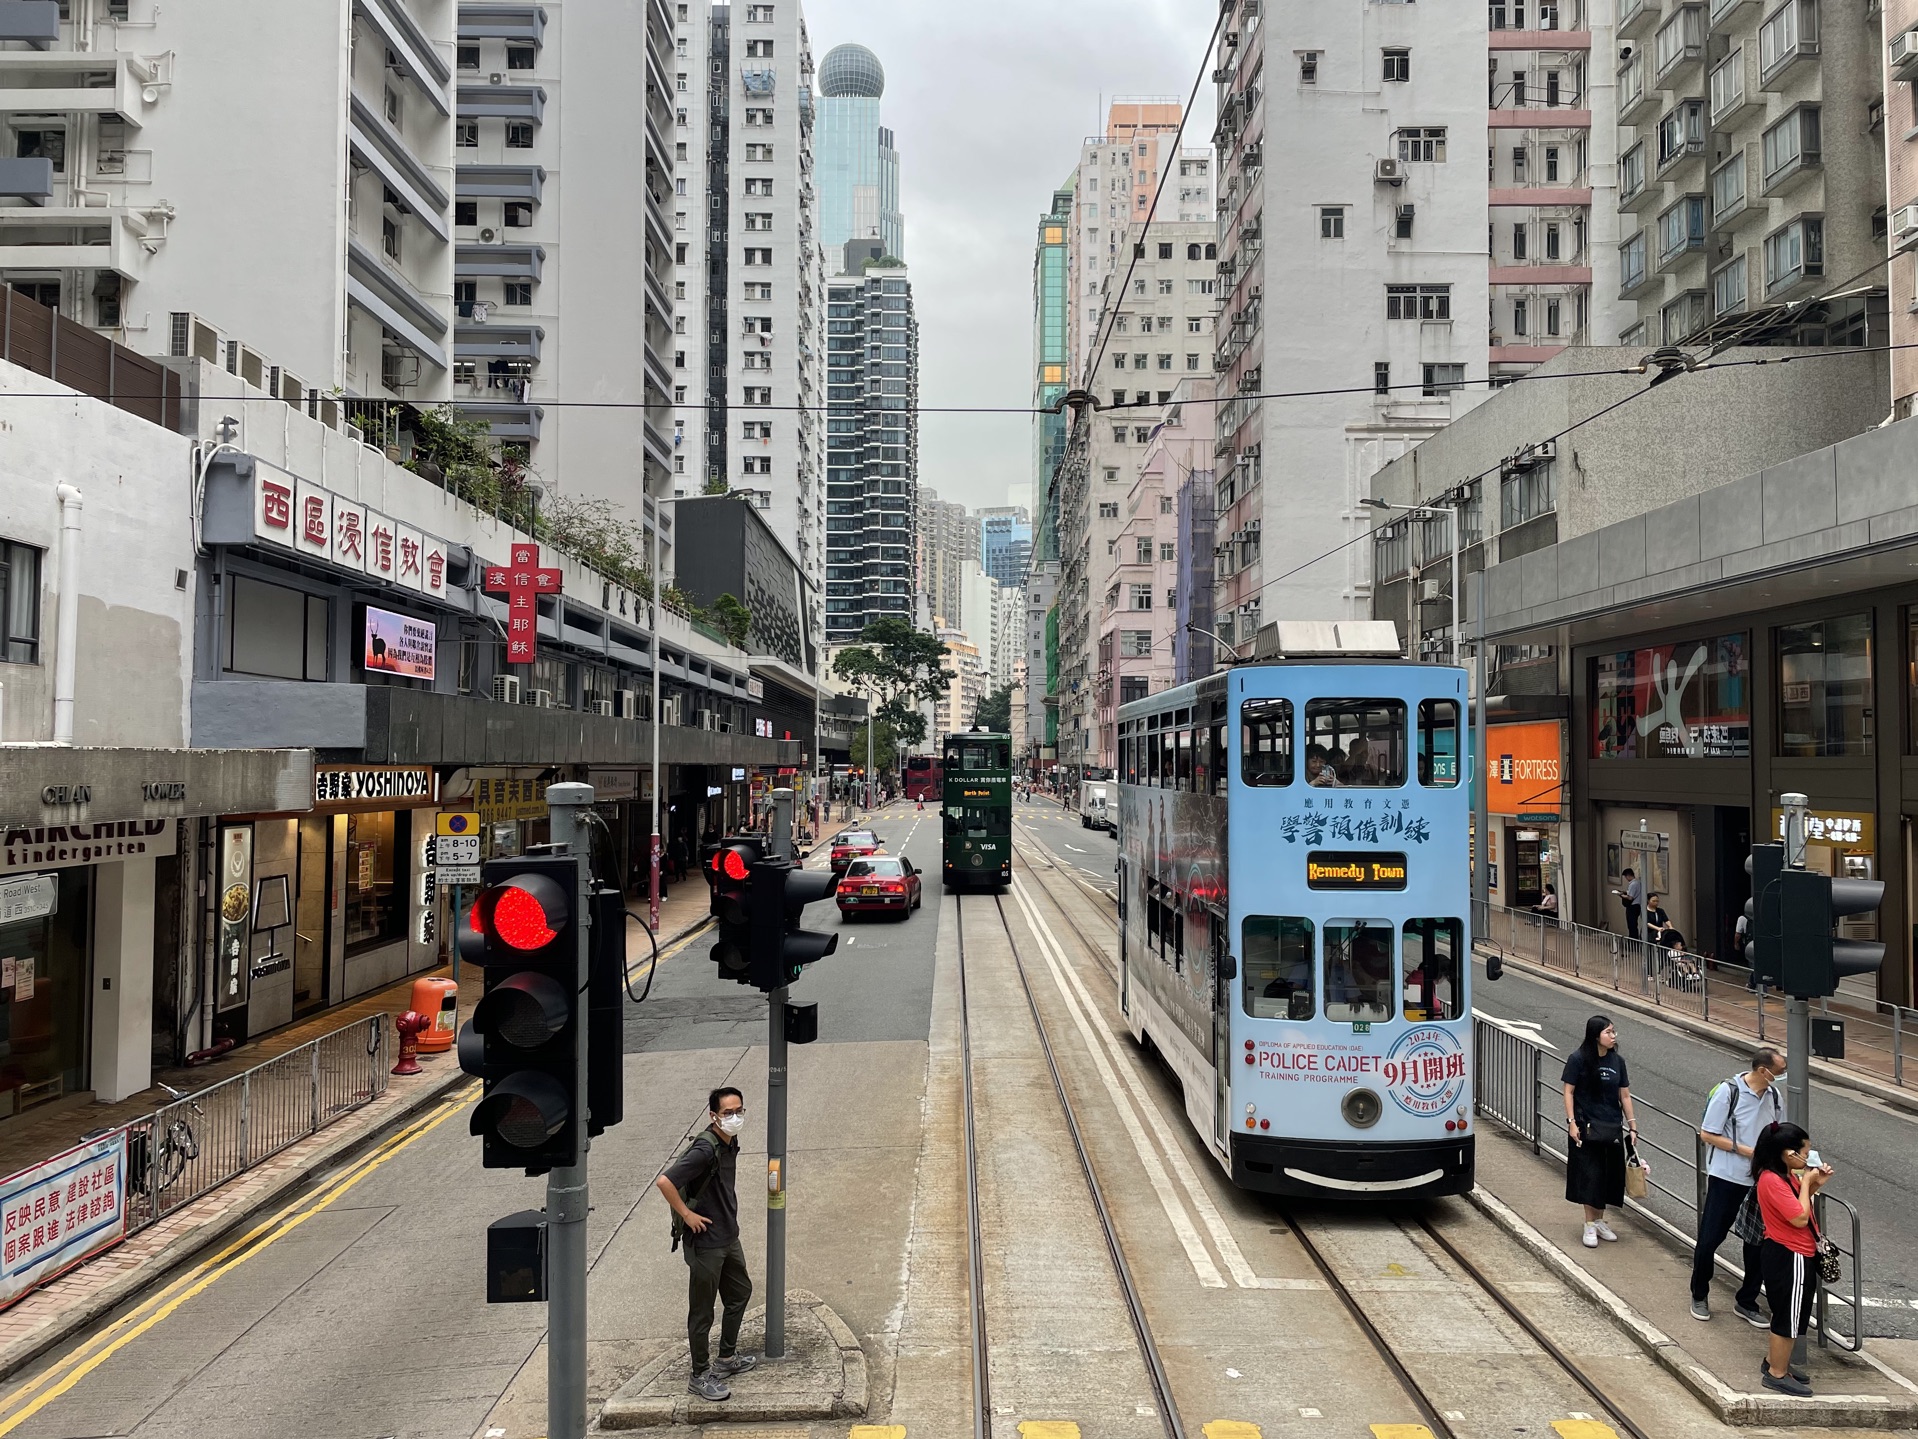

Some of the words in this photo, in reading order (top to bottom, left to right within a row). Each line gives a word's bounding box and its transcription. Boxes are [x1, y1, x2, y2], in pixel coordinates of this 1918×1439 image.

[262, 479, 445, 589] 西區浸信教會
[1514, 760, 1559, 780] FORTRESS
[41, 784, 92, 805] CHAN
[141, 781, 188, 801] TOWER
[317, 772, 351, 799] 吉野家
[356, 771, 429, 797] YOSHINOYA
[1304, 798, 1411, 809] 應用教育文憑
[1280, 810, 1431, 846] 學警預備訓練
[7, 842, 146, 866] kindergarten
[452, 839, 477, 848] 8-10
[1309, 863, 1365, 881] Kennedy
[1372, 863, 1404, 880] Town
[4, 887, 21, 898] Road
[24, 884, 41, 895] West
[1354, 1023, 1370, 1031] 028
[1259, 1051, 1318, 1071] POLICE
[1324, 1055, 1381, 1072] CADET
[1383, 1053, 1466, 1087] 9月開班
[1260, 1071, 1300, 1081] TRAINING
[1304, 1075, 1358, 1083] PROGRAMME
[4, 1190, 61, 1235] 反映民意
[65, 1164, 115, 1206] 建設社區
[4, 1219, 60, 1265] 個案跟進
[65, 1190, 115, 1233] 法律諮詢
